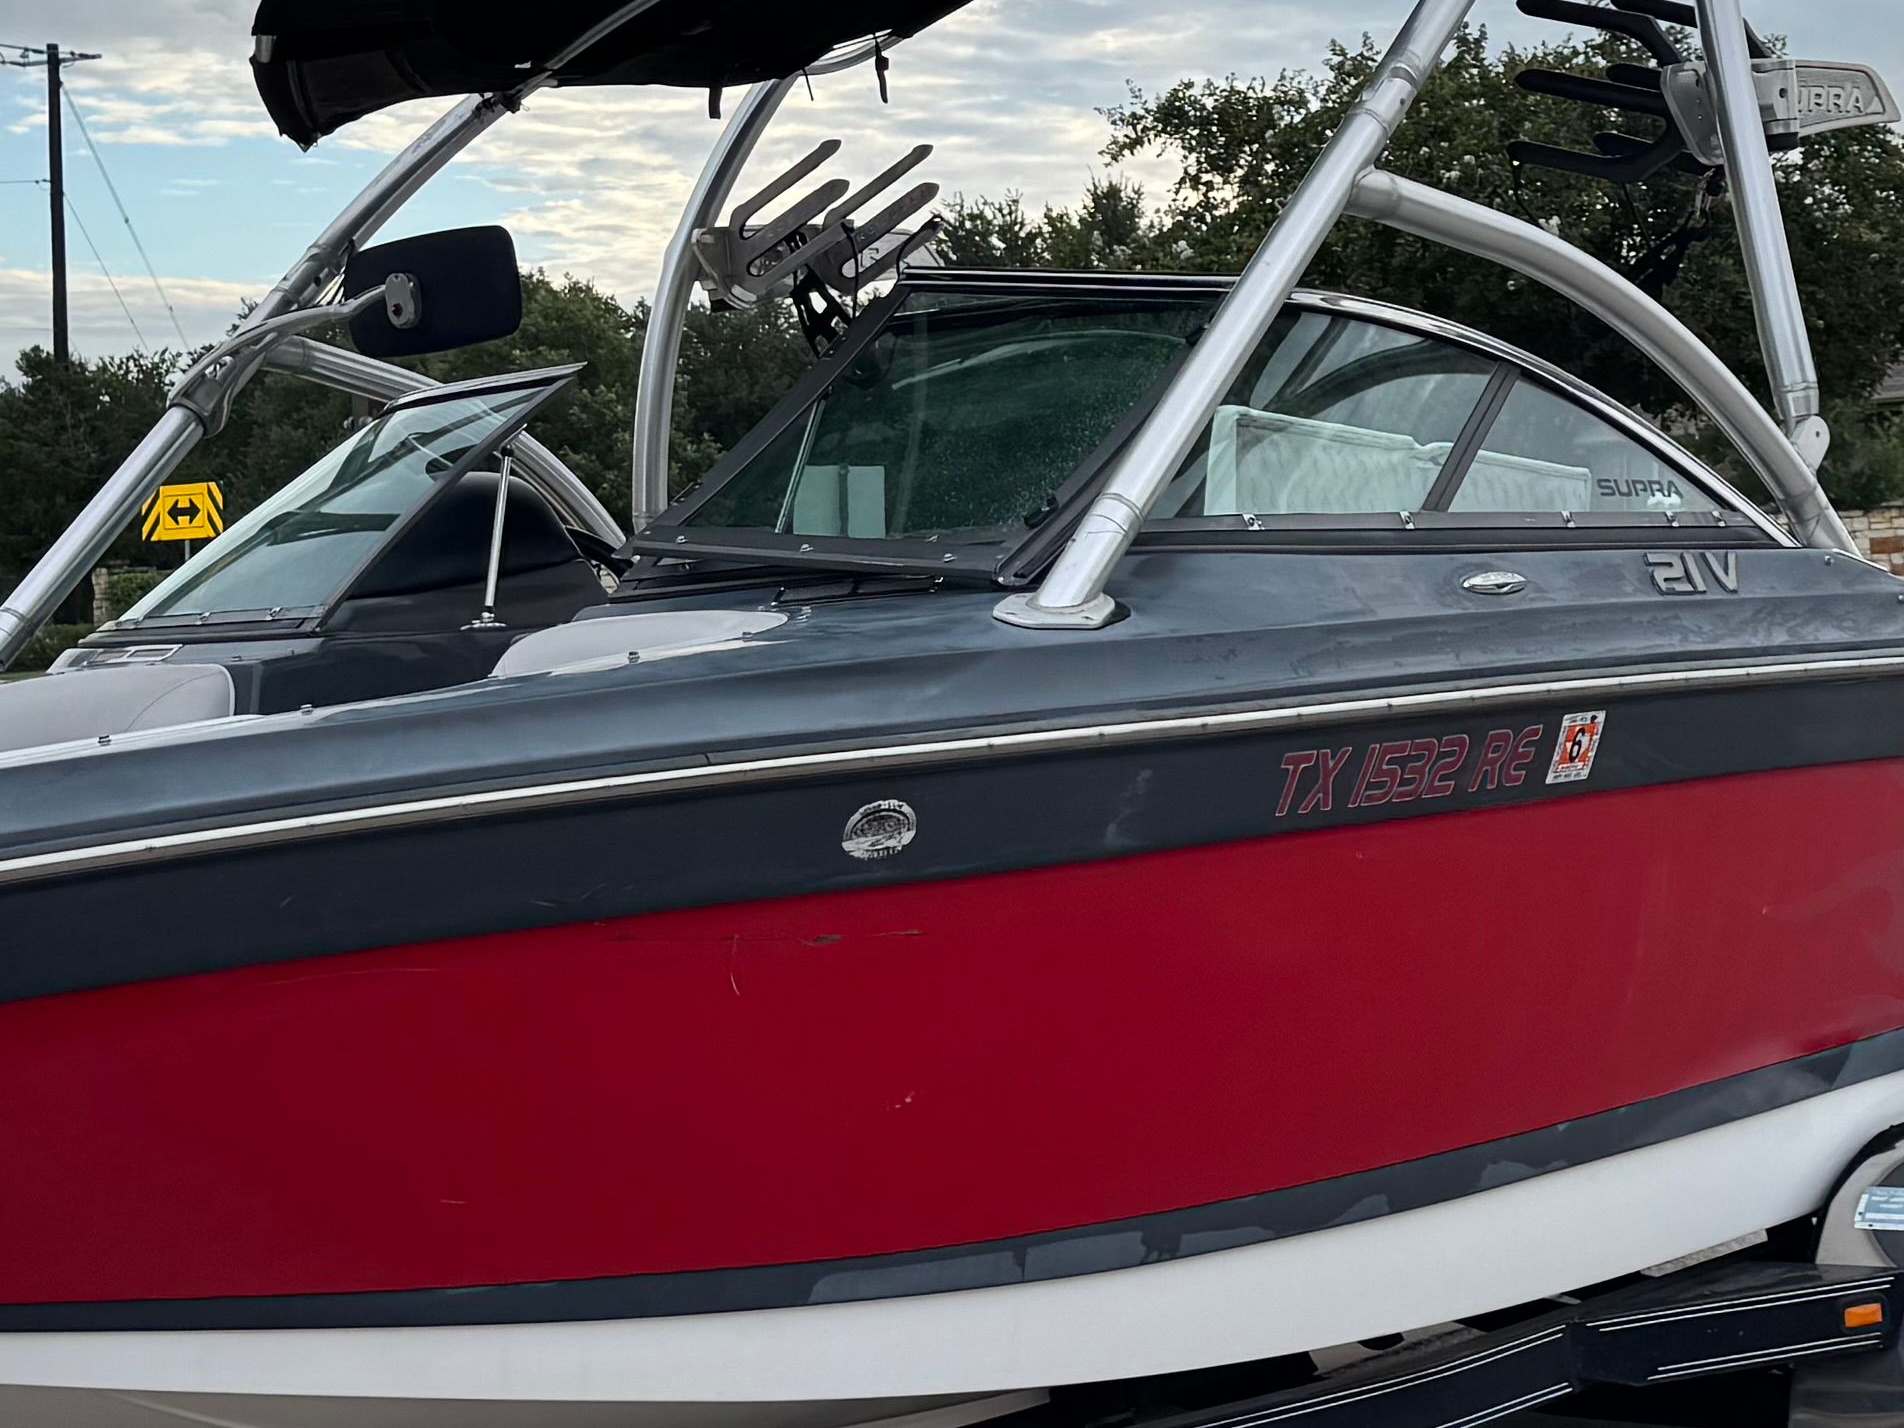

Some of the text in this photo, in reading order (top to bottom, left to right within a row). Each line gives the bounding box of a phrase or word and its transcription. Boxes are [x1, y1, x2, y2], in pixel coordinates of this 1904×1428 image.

[1798, 86, 1863, 113] PRA
[1597, 478, 1684, 498] SUPRA
[1569, 727, 1585, 763] 6
[1275, 724, 1544, 817] TX 1532 RE
